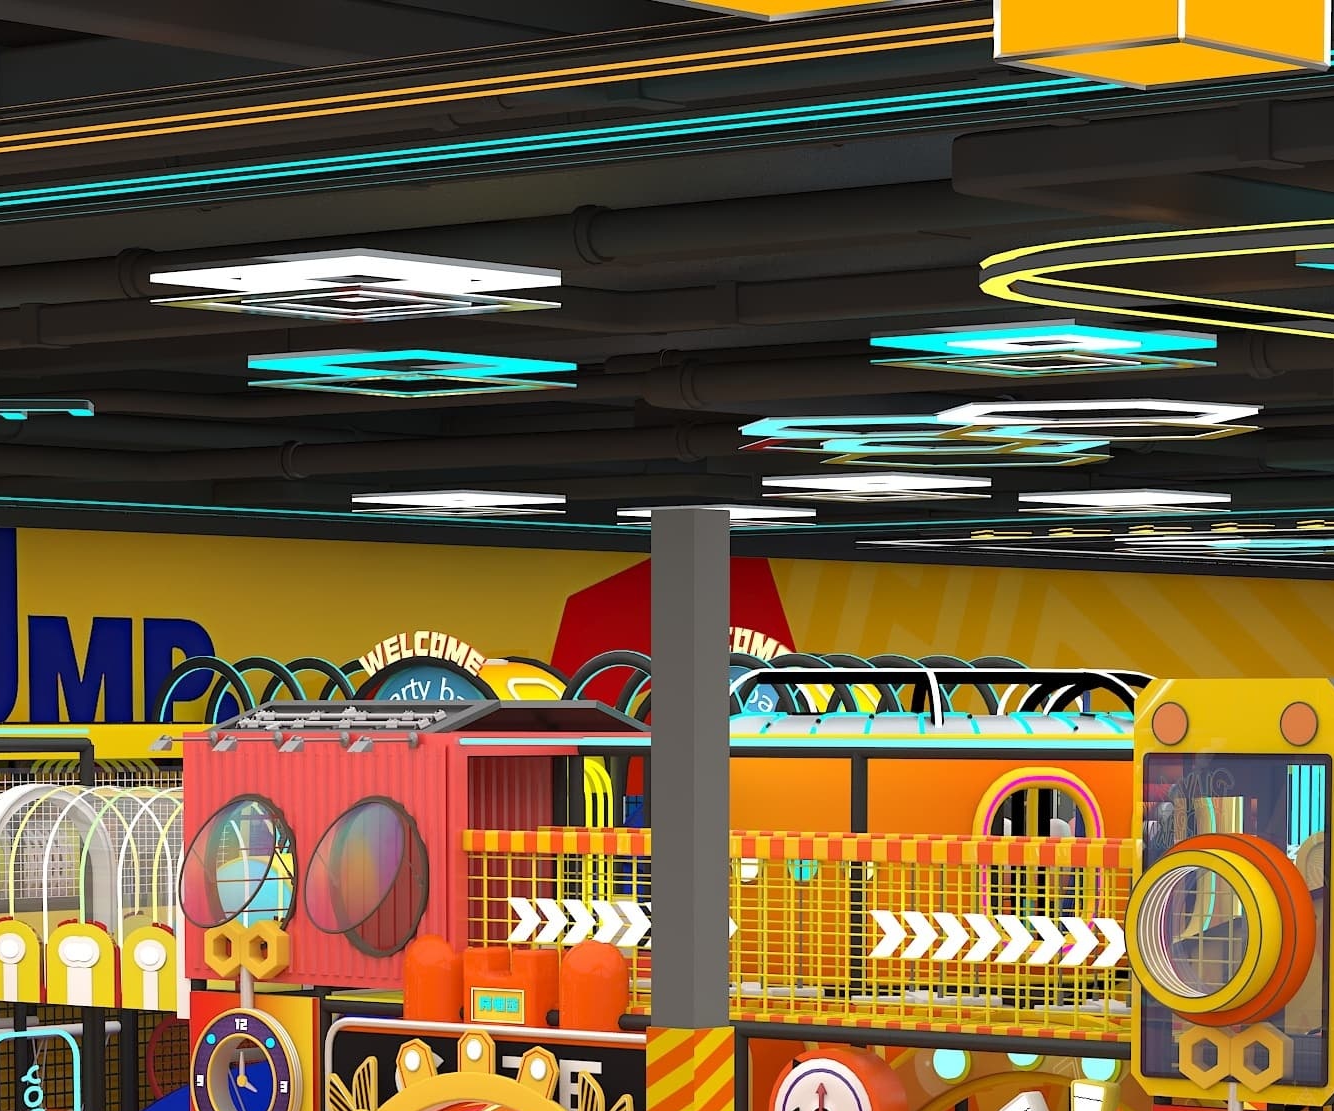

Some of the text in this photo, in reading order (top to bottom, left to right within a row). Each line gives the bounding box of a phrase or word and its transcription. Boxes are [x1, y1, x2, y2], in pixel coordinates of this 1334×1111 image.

[359, 631, 486, 677] WELCOME
[235, 1019, 248, 1030] 12
[280, 1081, 288, 1093] 3
